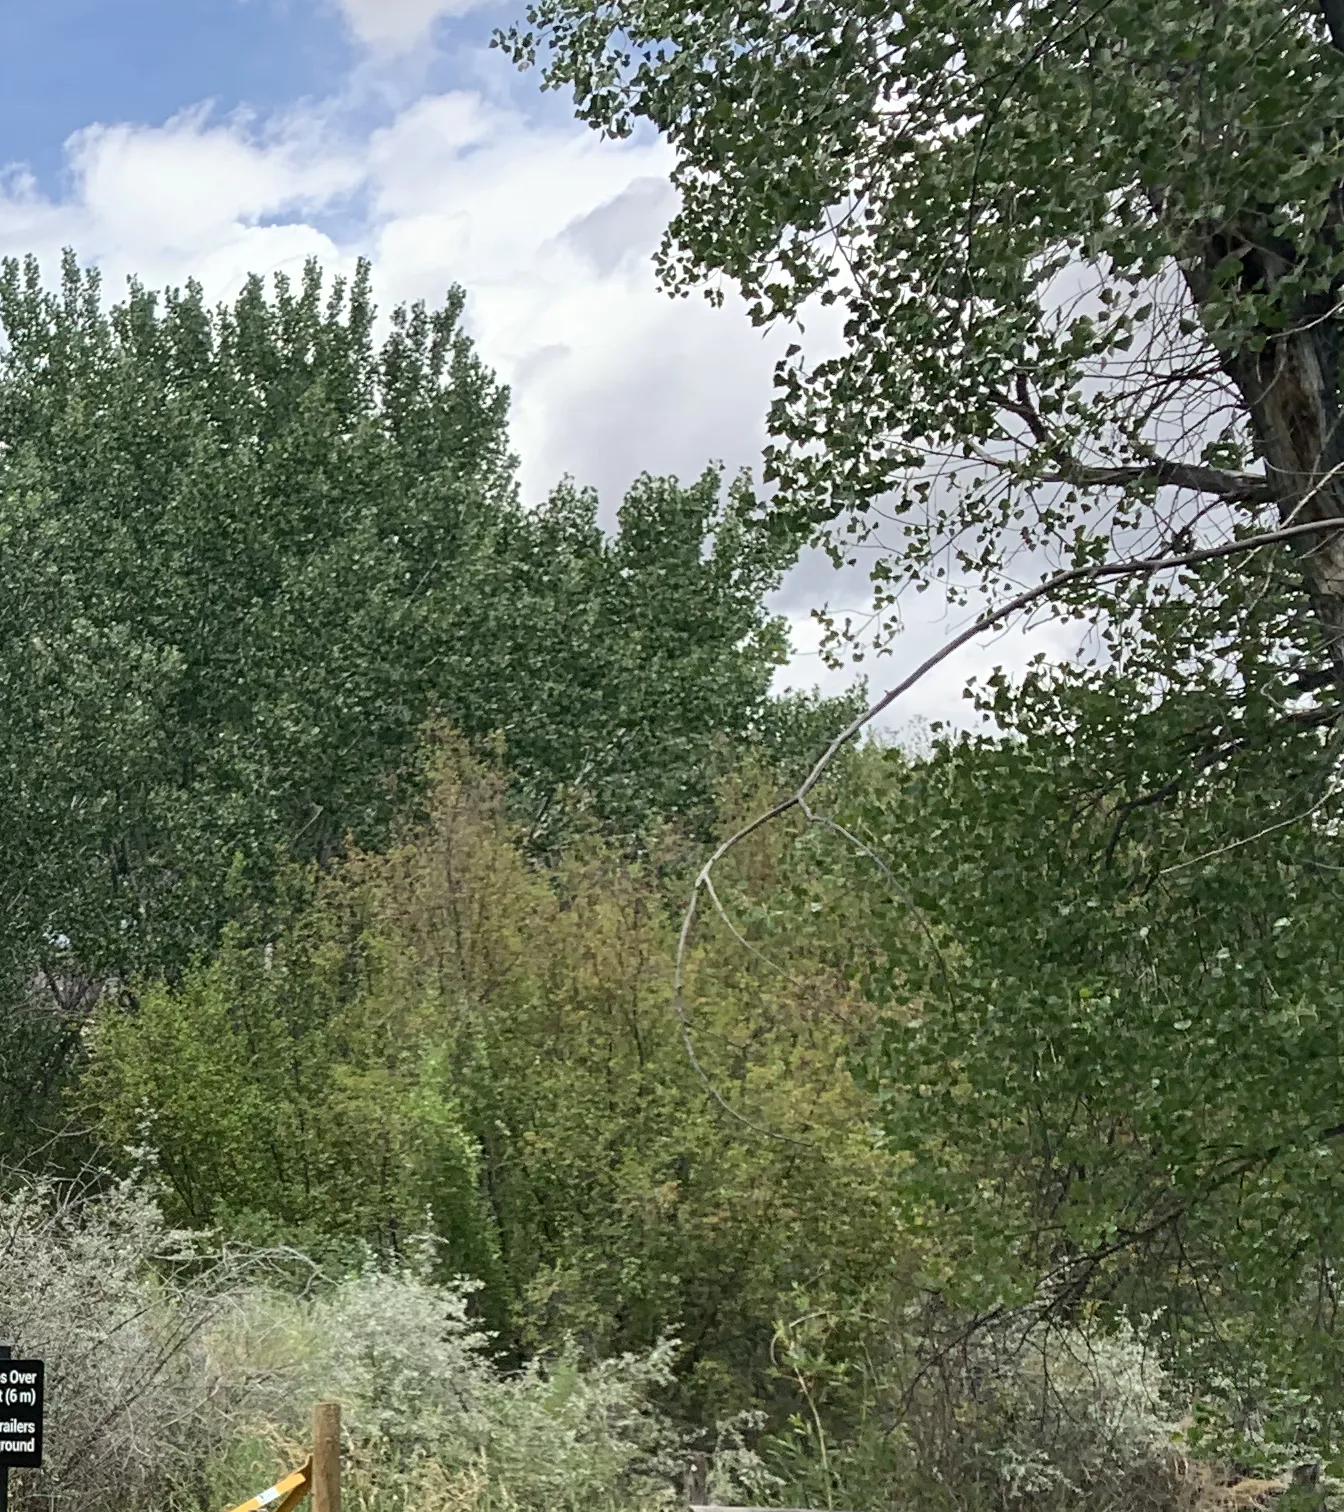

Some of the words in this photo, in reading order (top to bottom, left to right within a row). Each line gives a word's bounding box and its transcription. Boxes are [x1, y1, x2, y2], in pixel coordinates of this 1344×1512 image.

[9, 1370, 37, 1384] Over
[5, 1389, 18, 1406] (6
[19, 1388, 36, 1406] m)
